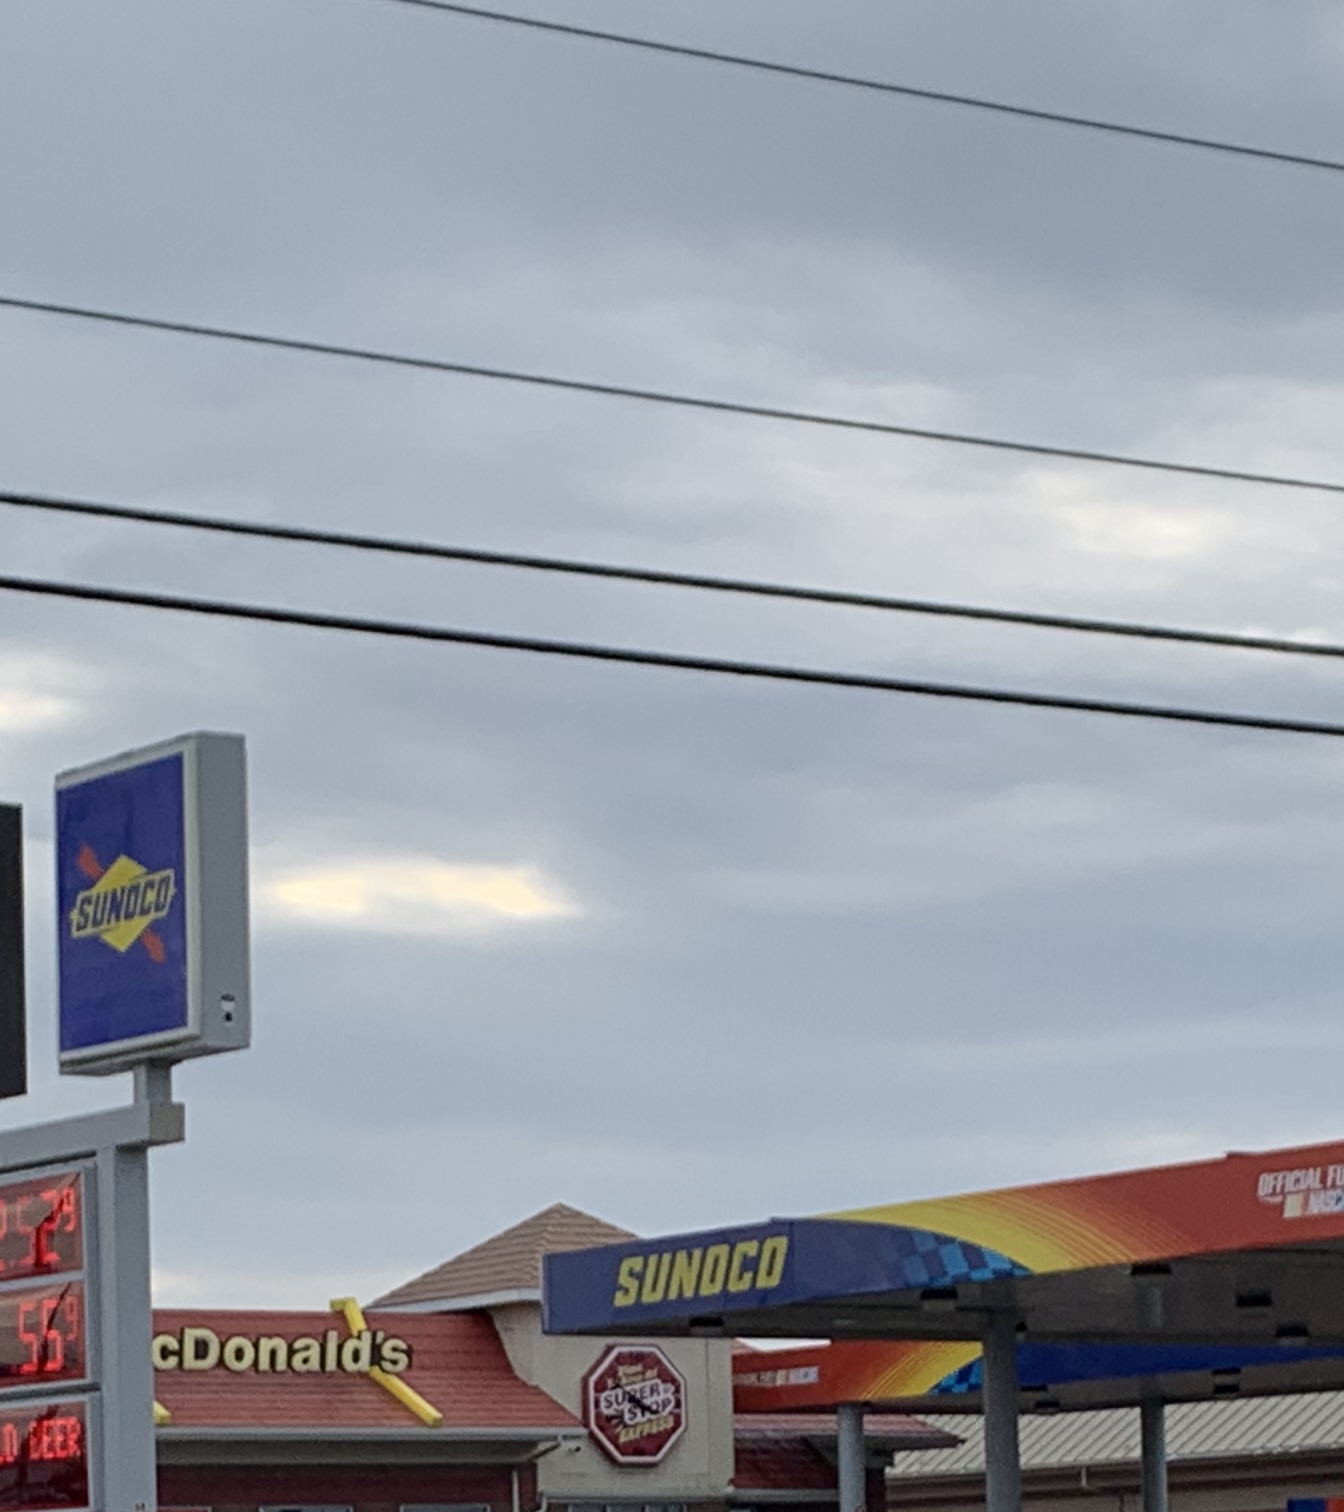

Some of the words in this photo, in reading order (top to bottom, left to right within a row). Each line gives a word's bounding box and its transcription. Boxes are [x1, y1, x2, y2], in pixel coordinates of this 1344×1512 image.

[73, 870, 174, 934] SUNOCO
[1258, 1166, 1323, 1196] OFFICIAL
[613, 1235, 788, 1307] SUNOCO
[152, 1327, 409, 1372] cDonald's
